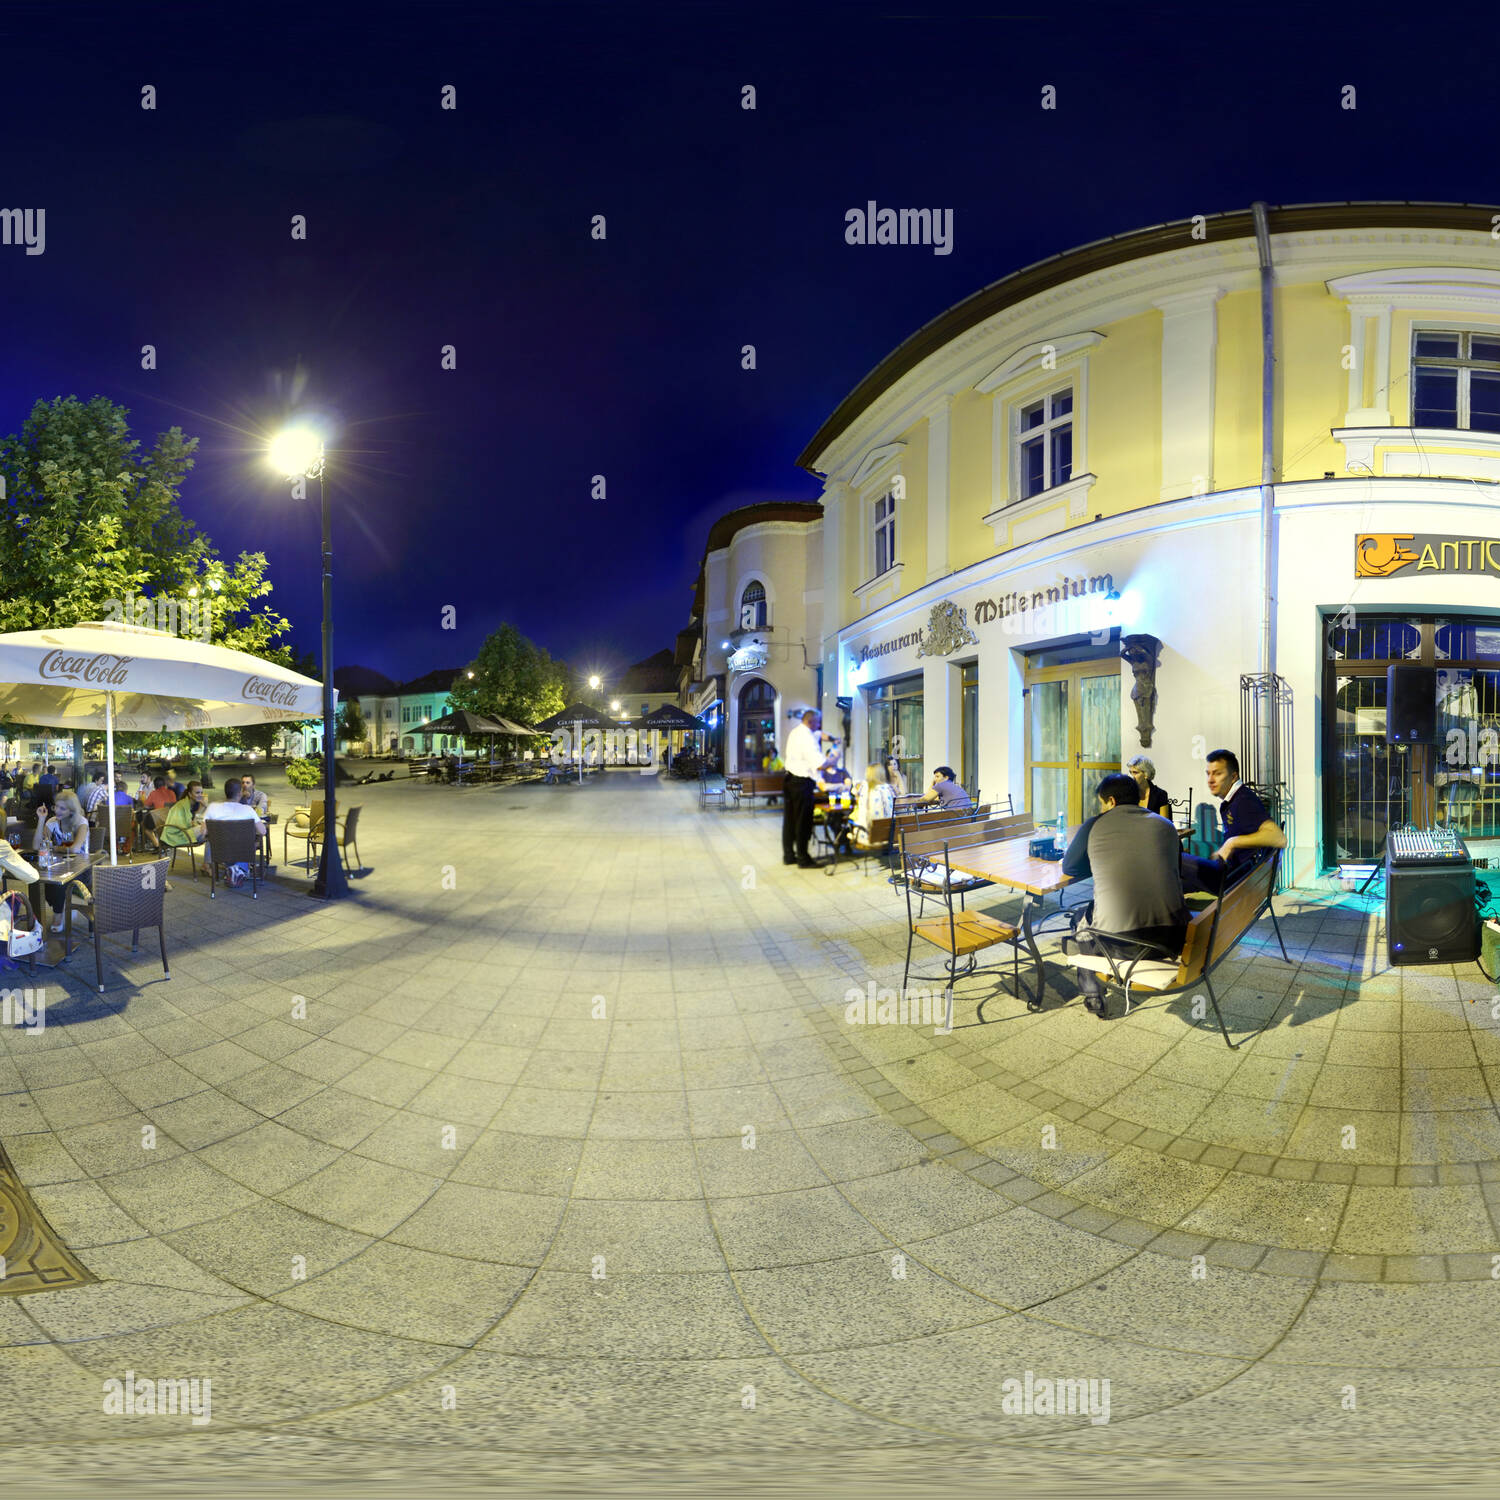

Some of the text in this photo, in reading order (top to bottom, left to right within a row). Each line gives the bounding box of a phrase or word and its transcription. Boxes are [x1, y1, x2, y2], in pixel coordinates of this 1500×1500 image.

[860, 572, 1114, 663] Restaurant Millennium
[39, 649, 137, 686] Coca-Cola
[241, 675, 303, 706] Coca-Cola
